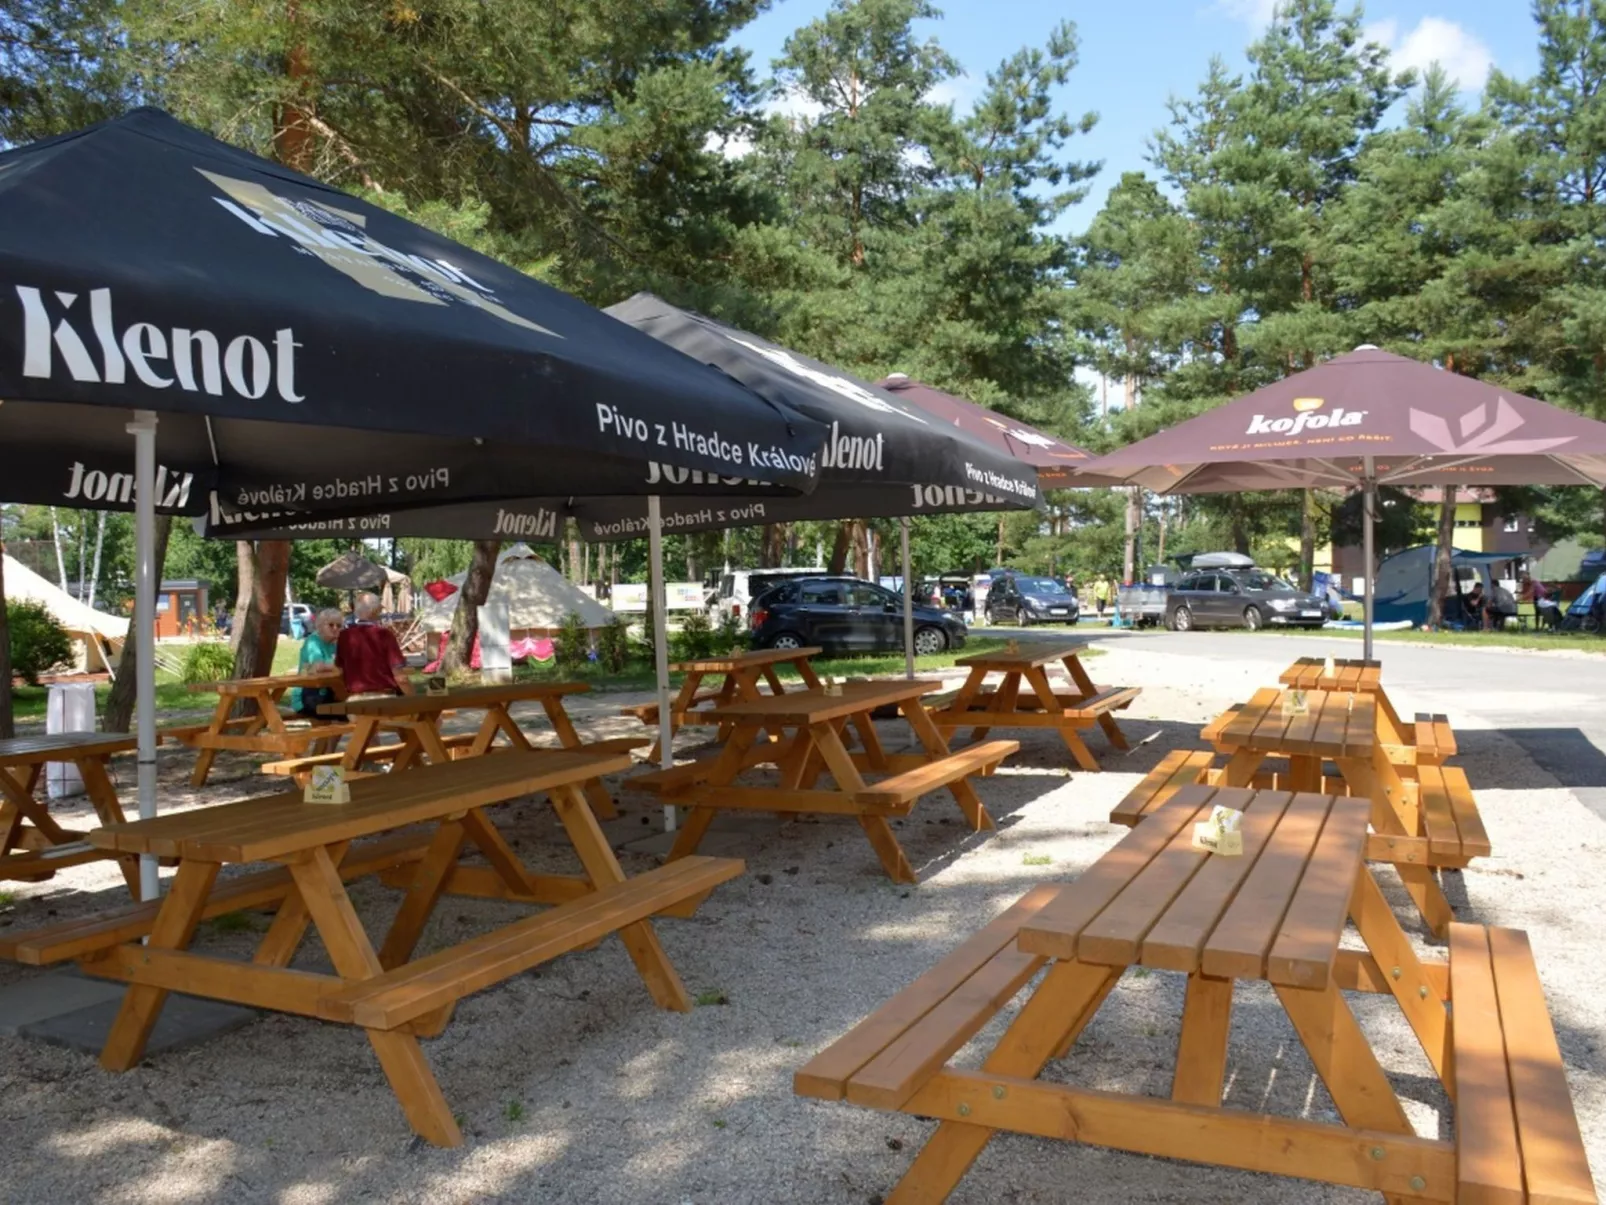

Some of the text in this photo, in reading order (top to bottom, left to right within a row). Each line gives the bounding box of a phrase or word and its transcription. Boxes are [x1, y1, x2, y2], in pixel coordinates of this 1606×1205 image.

[15, 284, 306, 403] Klenot
[596, 402, 648, 441] Pivo
[655, 424, 667, 446] z
[672, 421, 742, 464] Hradce
[748, 442, 816, 478] Králové
[1245, 408, 1363, 436] kofola
